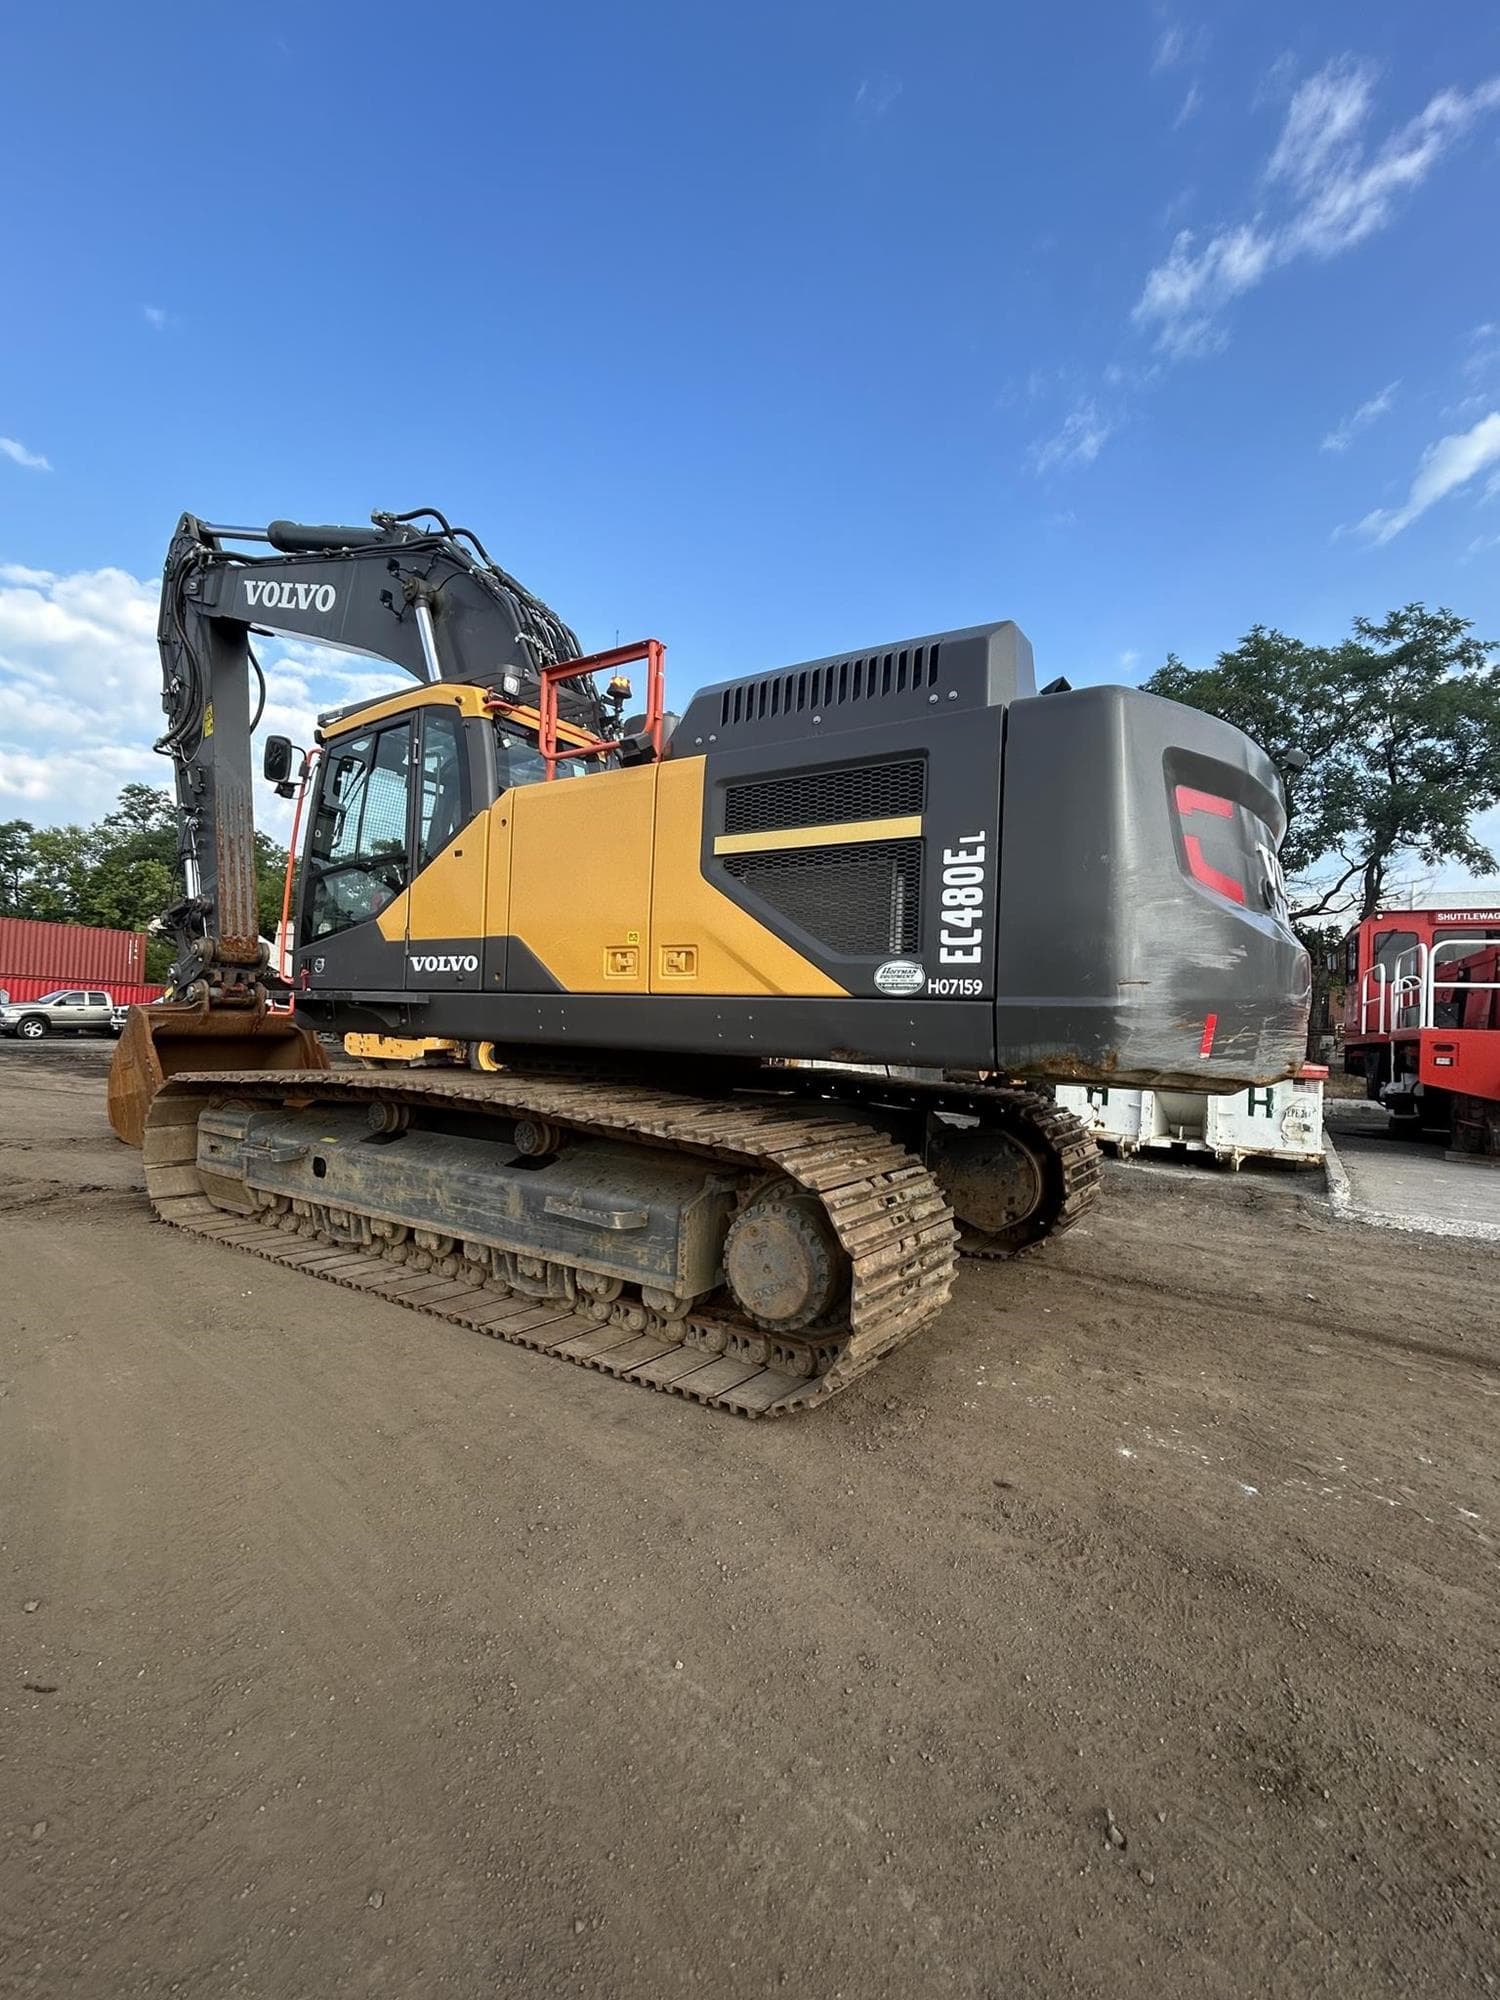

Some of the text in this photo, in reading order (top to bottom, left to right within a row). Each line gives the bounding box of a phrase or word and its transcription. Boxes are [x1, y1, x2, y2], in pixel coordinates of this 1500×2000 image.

[244, 580, 336, 612] VOLVO
[940, 831, 985, 963] EC480EL
[1437, 912, 1500, 920] SHUTTLEWAG
[410, 955, 478, 971] VOLVO
[928, 978, 983, 995] H07159
[1248, 1087, 1273, 1118] H
